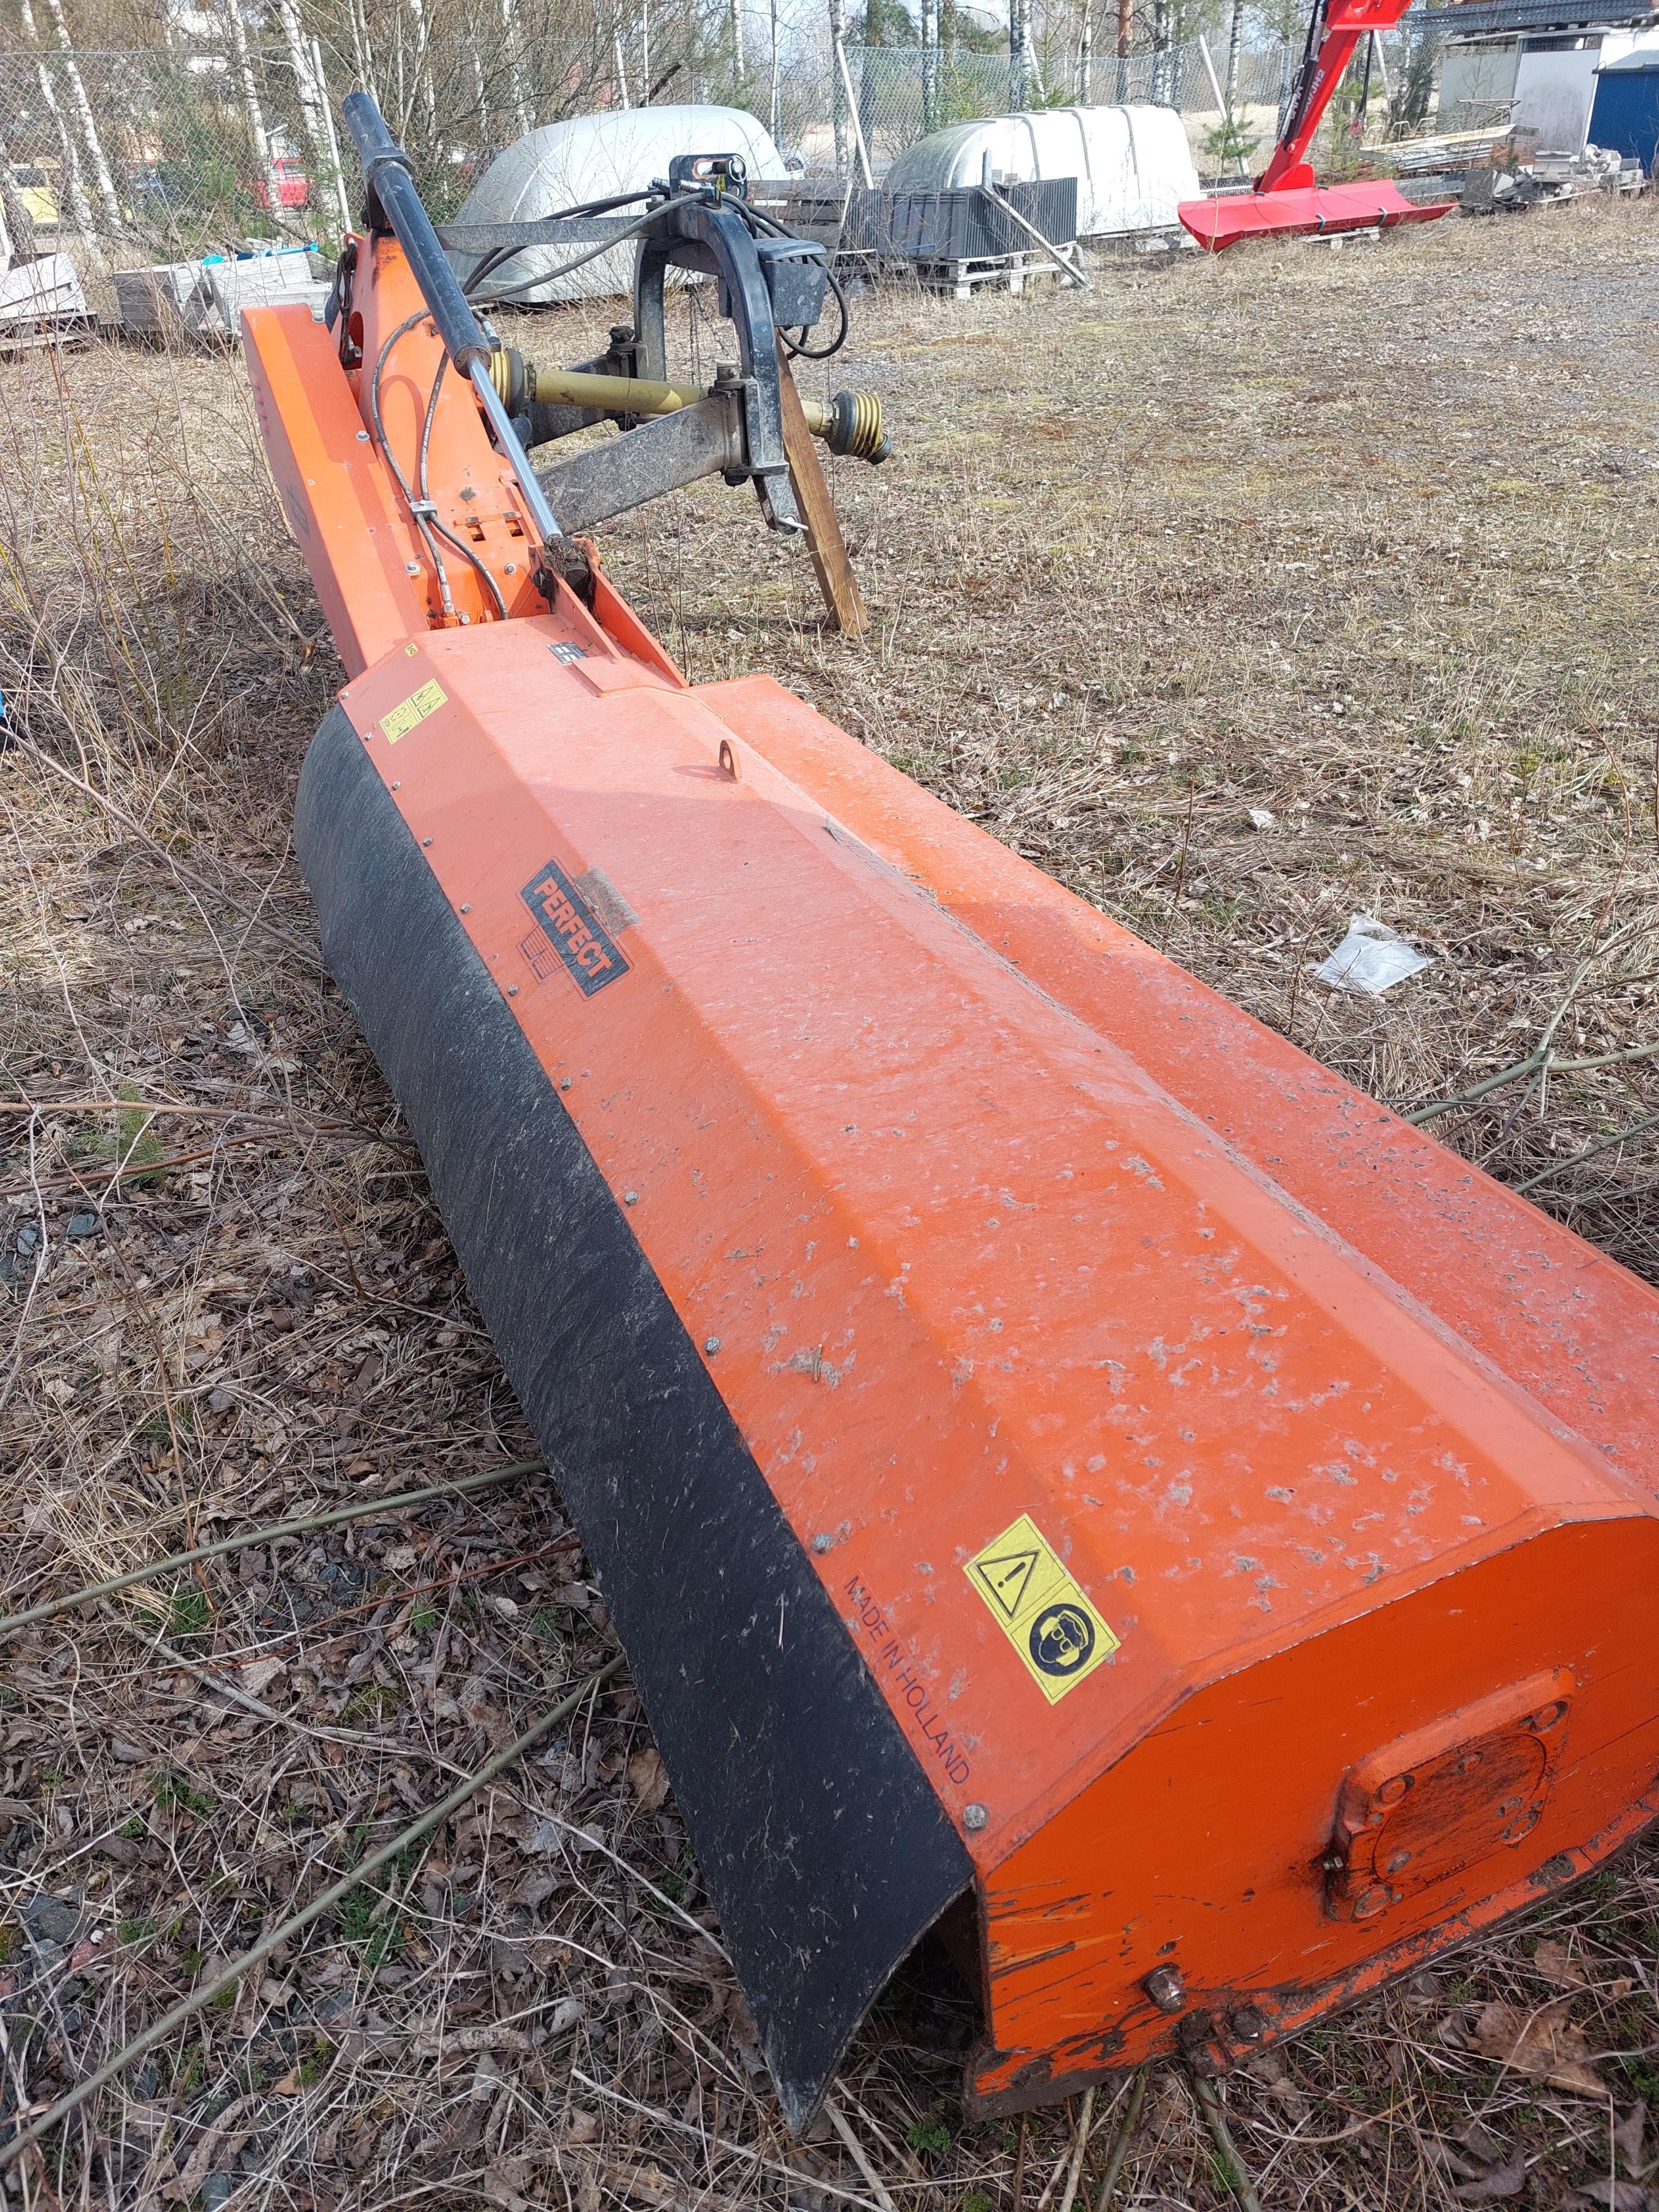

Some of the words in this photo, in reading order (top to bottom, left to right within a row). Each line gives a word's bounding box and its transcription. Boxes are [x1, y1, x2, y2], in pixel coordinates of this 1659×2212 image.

[533, 877, 612, 978] PERFECT
[844, 1576, 889, 1642] MADE
[881, 1639, 904, 1670] IN
[896, 1668, 969, 1784] HOLLAND
